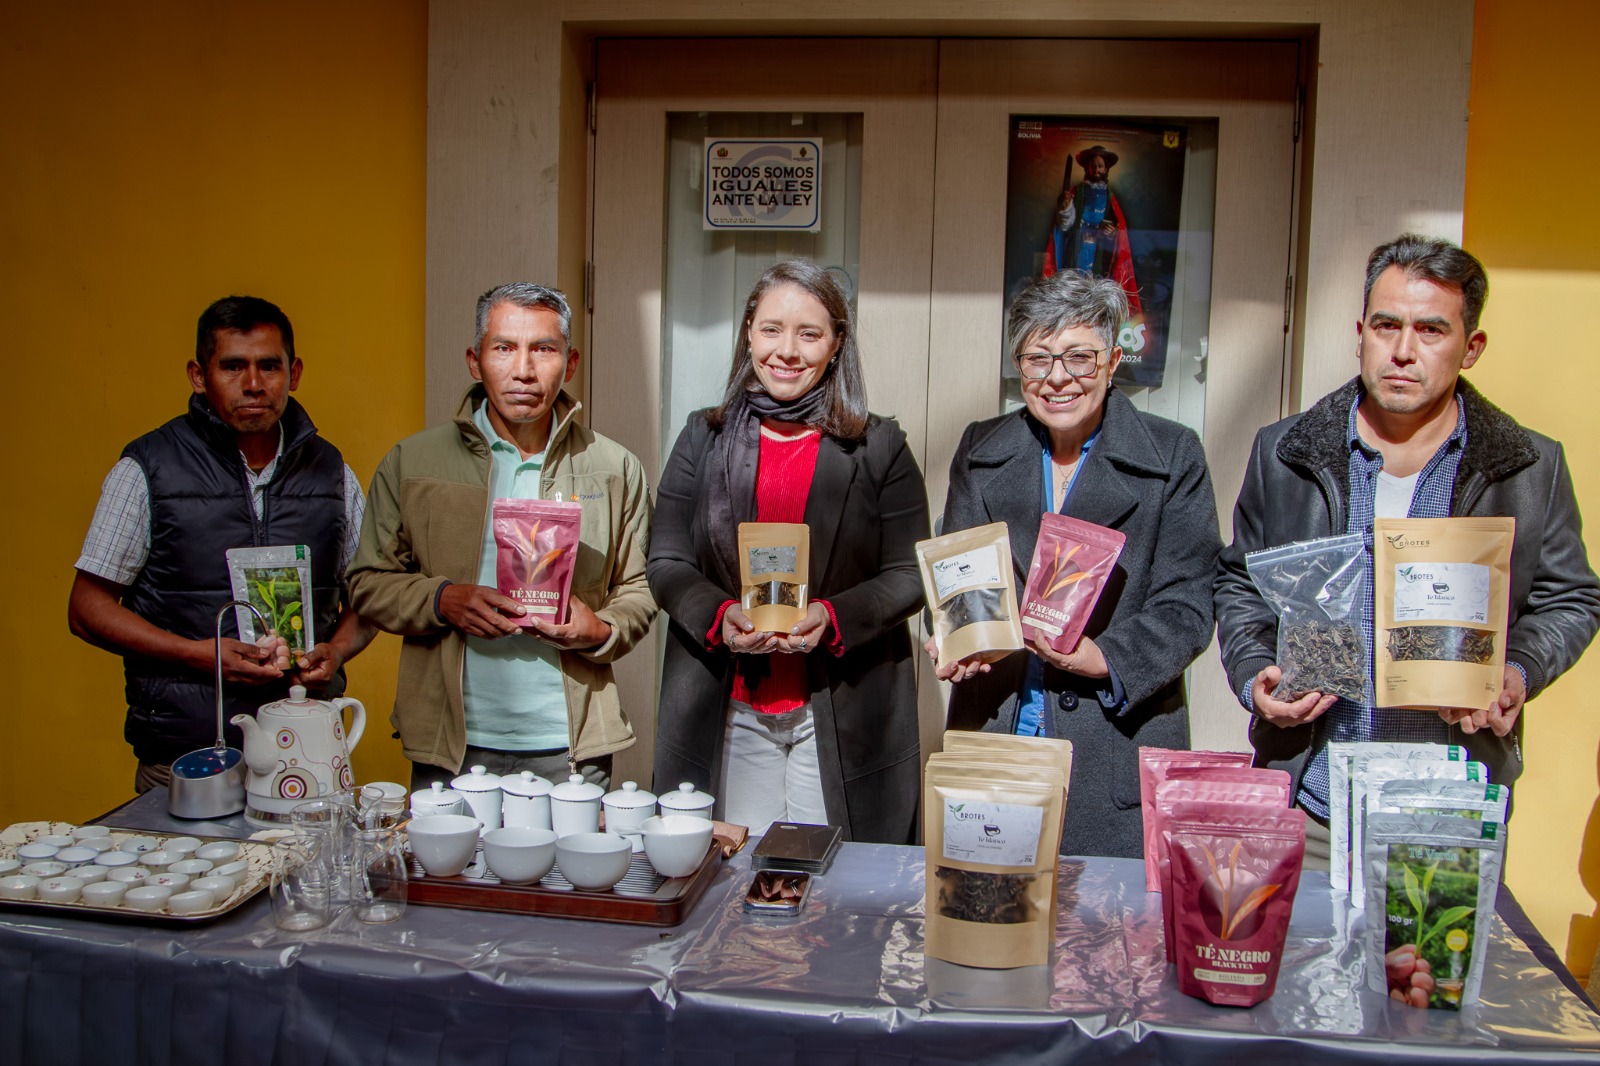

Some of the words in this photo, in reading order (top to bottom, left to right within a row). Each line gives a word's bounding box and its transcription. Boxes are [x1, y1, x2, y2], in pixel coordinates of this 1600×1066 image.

[712, 166, 760, 178] TODOS
[764, 166, 814, 178] SOMOS
[712, 180, 813, 192] IGUALES
[712, 193, 754, 206] ANTE
[758, 194, 778, 206] LA
[783, 194, 812, 206] LEY
[1120, 354, 1142, 363] 2024
[1399, 539, 1431, 547] BROTES
[1410, 573, 1434, 581] BROTES
[509, 587, 524, 598] TÉ
[525, 590, 560, 601] NEGRO
[1035, 604, 1071, 623] NEGRO
[960, 812, 986, 821] BROTES
[1408, 847, 1424, 859] Té
[1425, 848, 1460, 861] Verde
[1388, 914, 1402, 923] 100
[1403, 917, 1414, 926] gr
[1195, 943, 1216, 960] TÉ
[1217, 949, 1271, 963] NEGRO
[1212, 960, 1237, 969] BLACK
